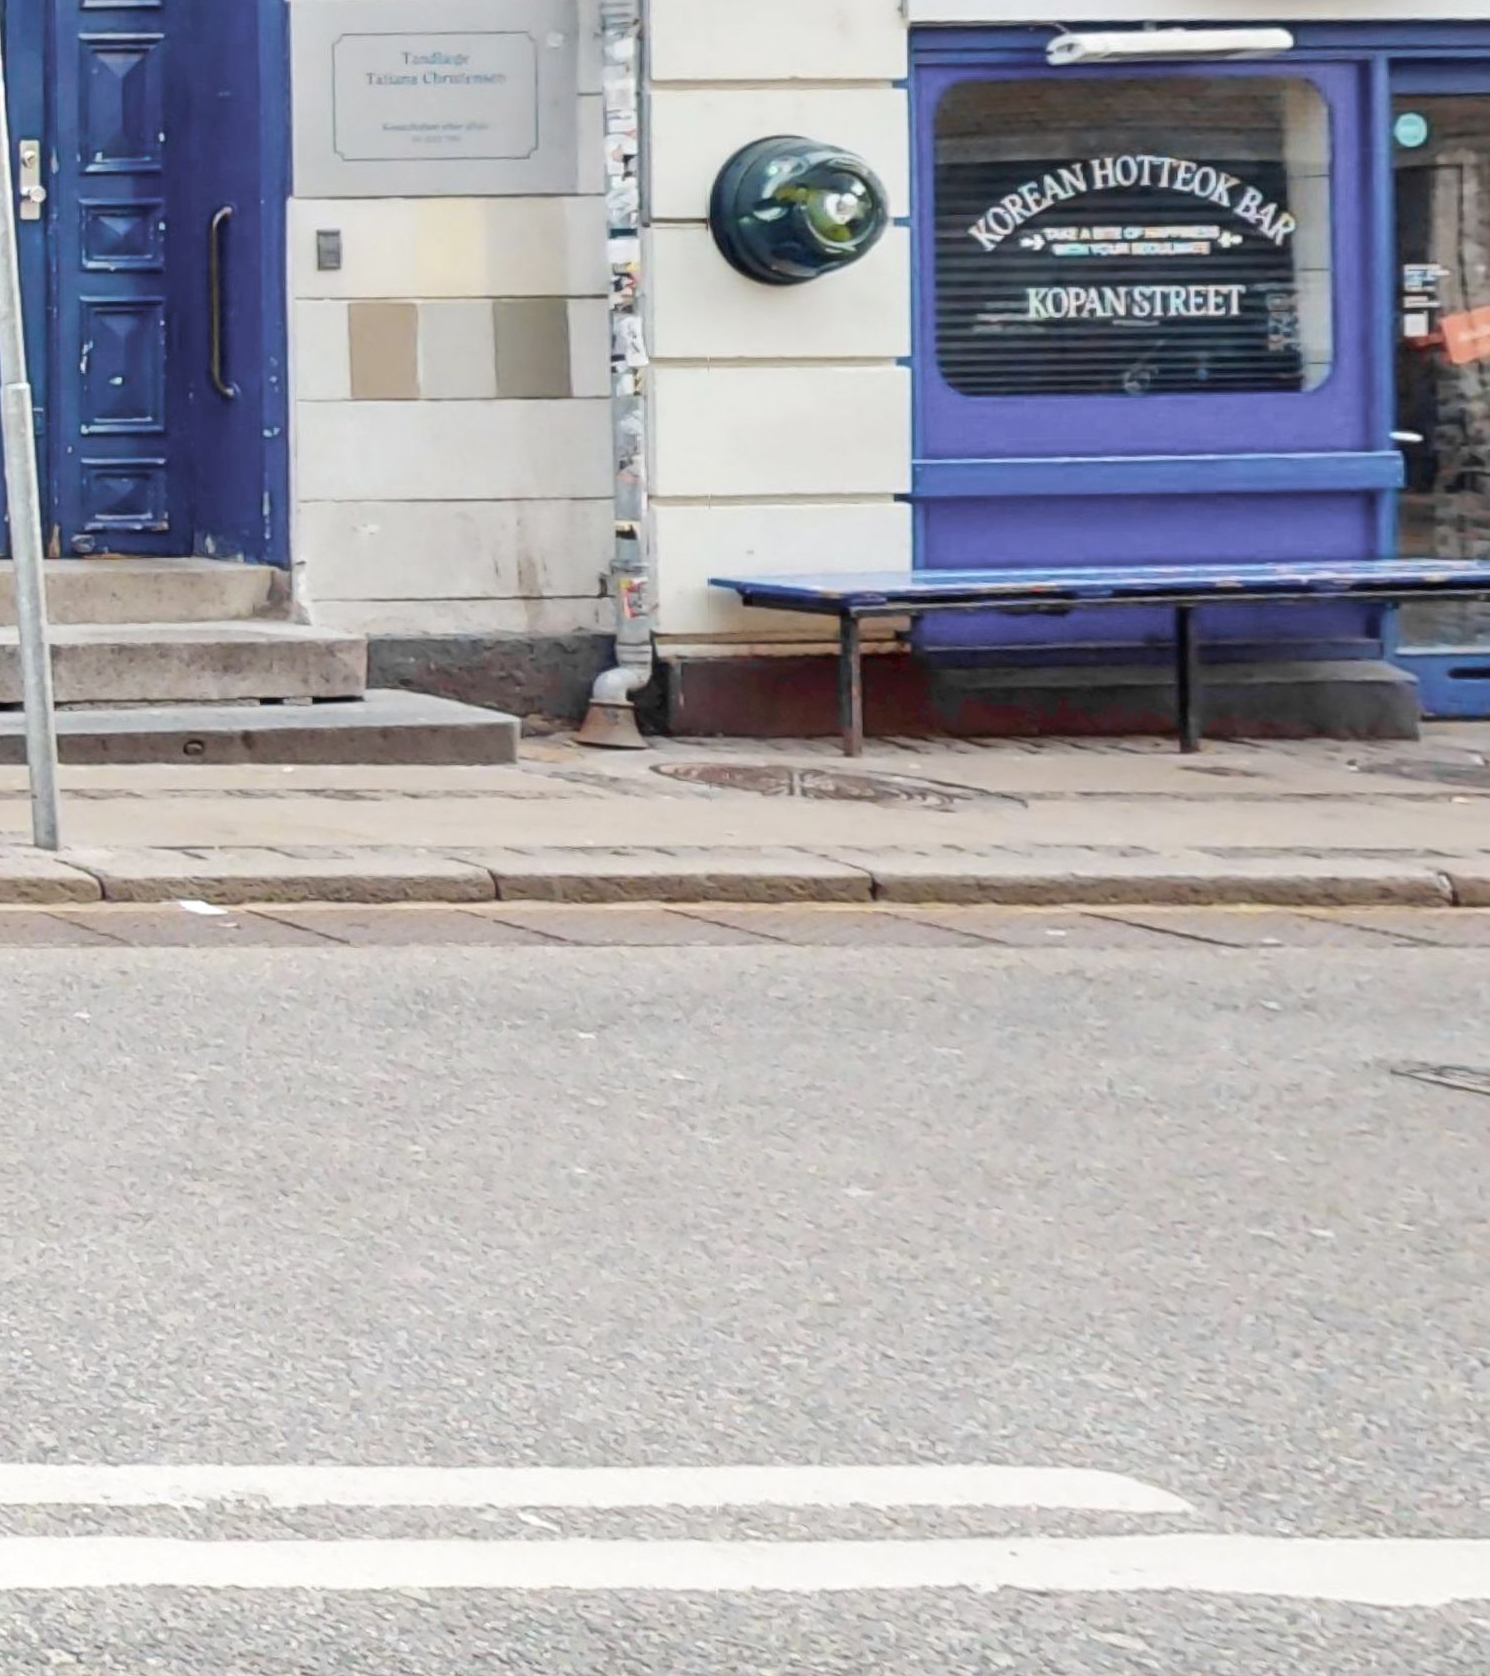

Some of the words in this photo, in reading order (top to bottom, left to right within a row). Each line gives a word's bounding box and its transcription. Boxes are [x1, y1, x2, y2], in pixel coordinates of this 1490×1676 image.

[967, 163, 1088, 252] KOREAN
[1089, 155, 1241, 208] HOTTEOK
[1234, 186, 1297, 245] BAR
[1025, 287, 1127, 318] KOPAN
[1132, 285, 1246, 317] STREET
